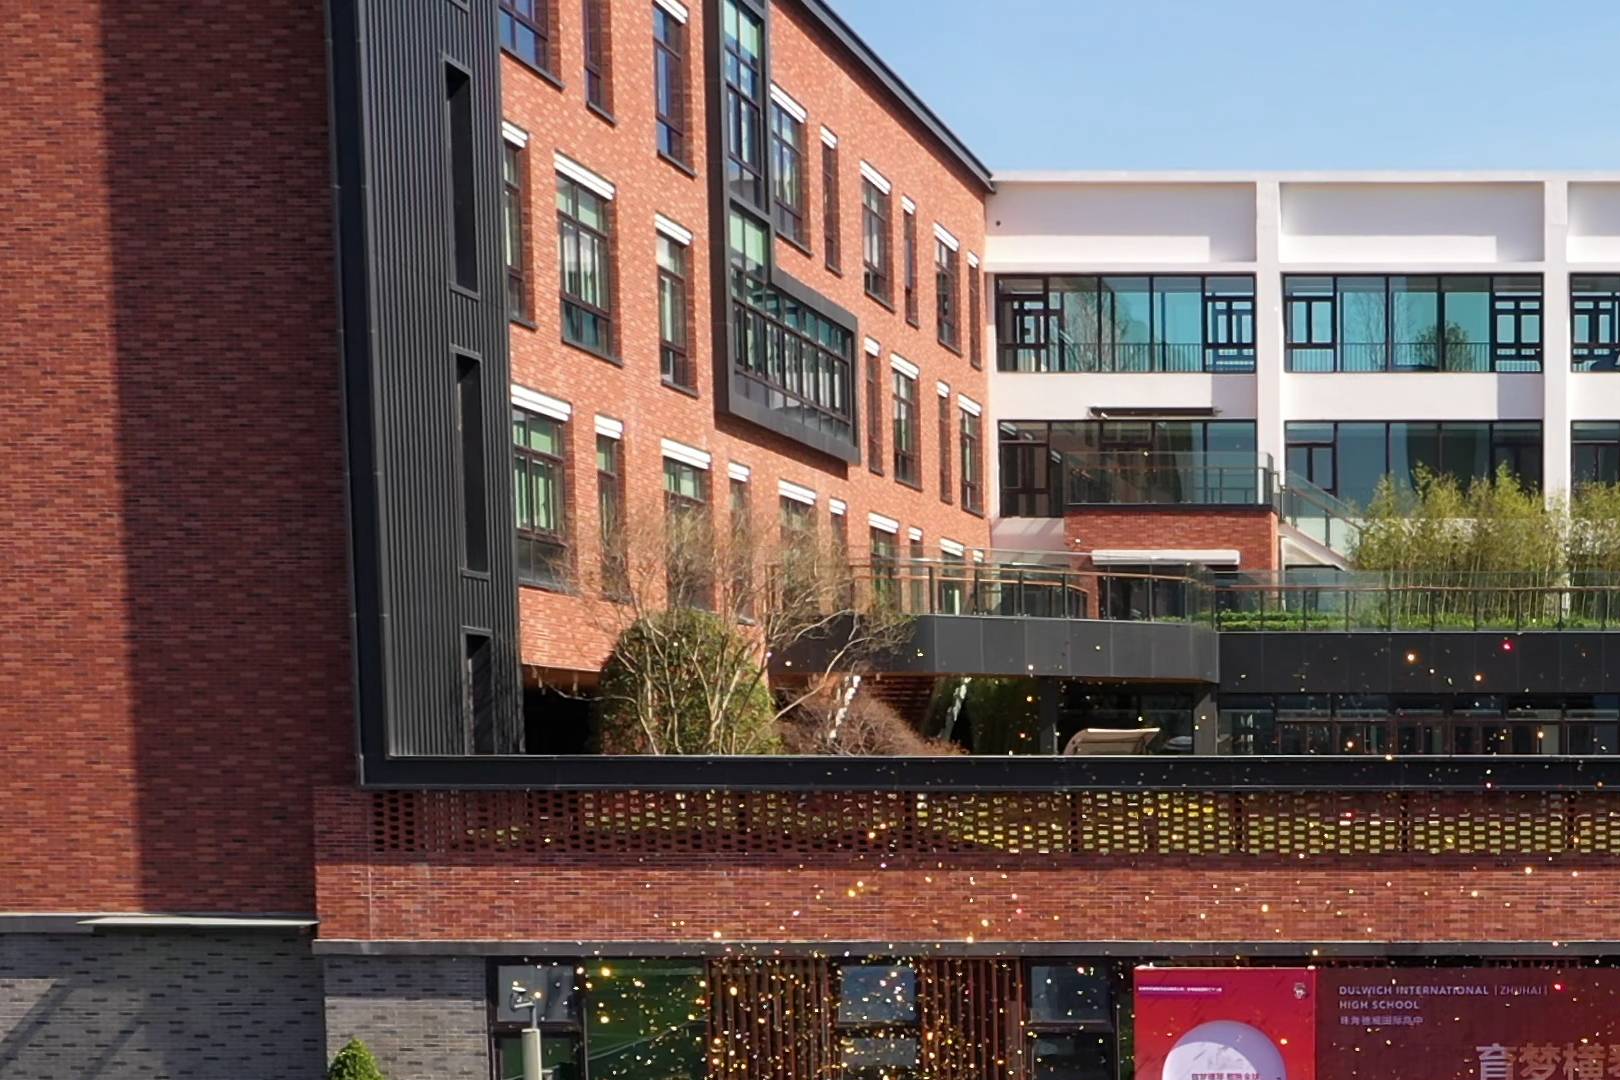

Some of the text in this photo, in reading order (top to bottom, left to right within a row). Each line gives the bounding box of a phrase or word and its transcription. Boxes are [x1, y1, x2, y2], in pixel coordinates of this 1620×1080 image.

[1339, 985, 1392, 996] DULWICH
[1396, 985, 1489, 996] INTERNATIONAL
[1339, 1000, 1420, 1010] HIGH SCHOOL
